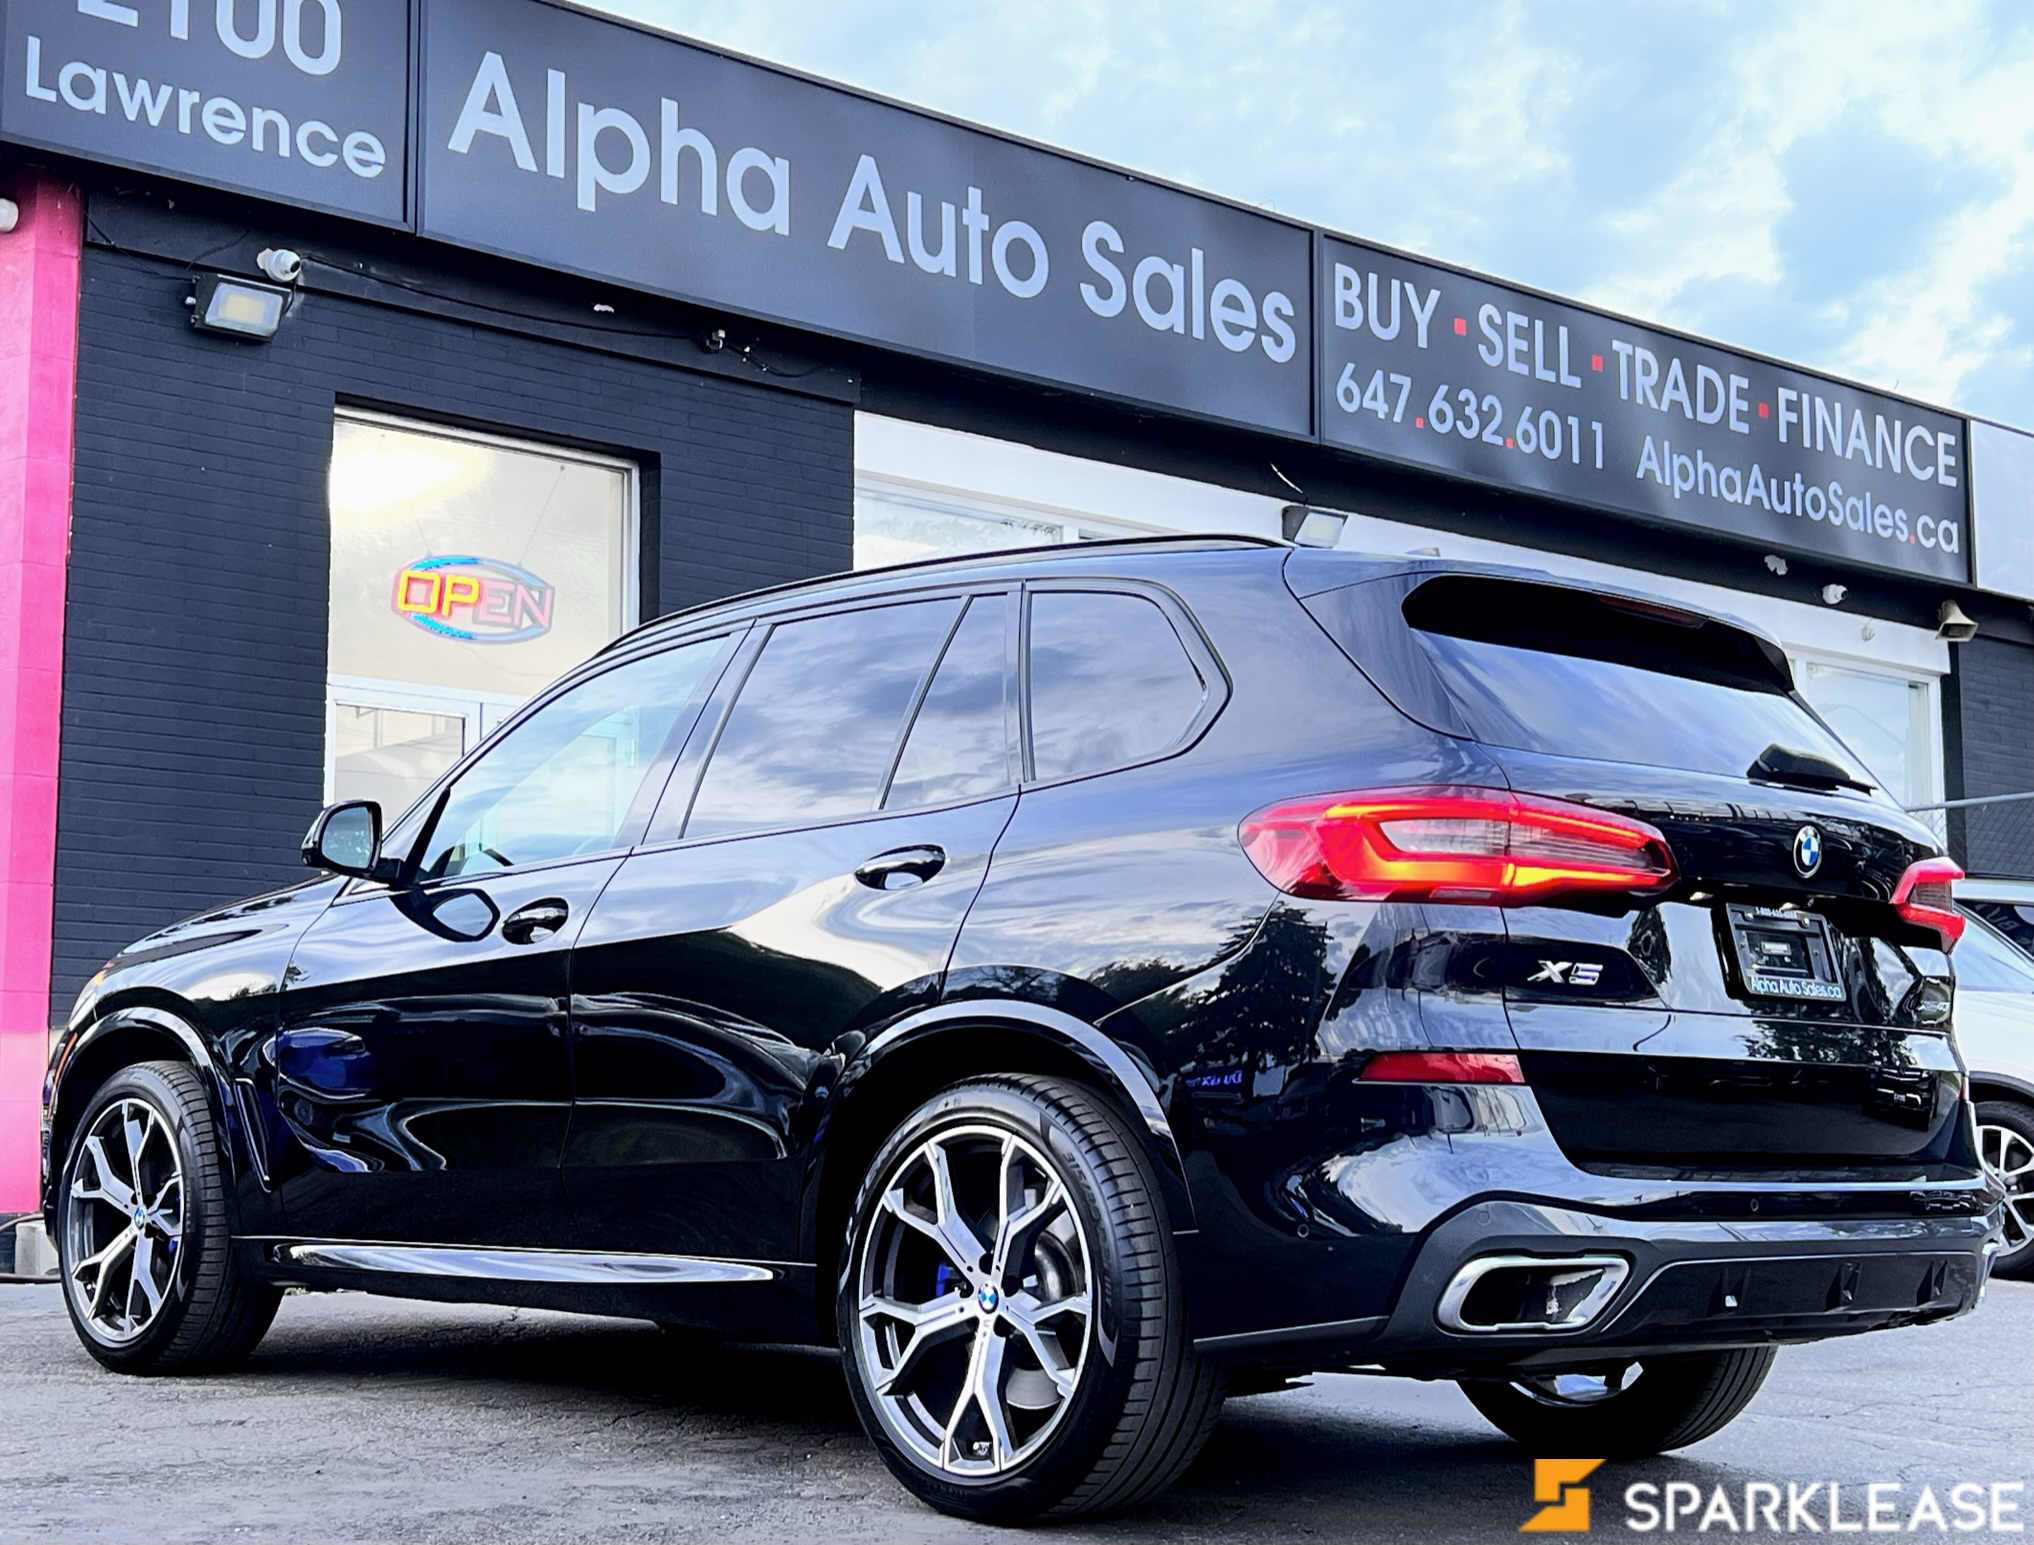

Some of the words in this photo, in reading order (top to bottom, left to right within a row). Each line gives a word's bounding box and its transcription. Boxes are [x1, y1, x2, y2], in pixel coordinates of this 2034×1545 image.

[77, 0, 342, 76] 00
[26, 36, 386, 178] Lawrence
[447, 50, 791, 237] Alpha
[827, 154, 1049, 298] Auto
[1079, 220, 1297, 364] Sales
[1334, 262, 1441, 349] BUY
[1478, 303, 1582, 389] SELL
[1612, 339, 1750, 434] TRADE
[1777, 387, 1958, 488] FINANCE
[1336, 362, 1604, 470] 647.632.6011
[1636, 435, 1960, 554] AlphaAutoSales.ca
[397, 571, 553, 629] OPEN
[1527, 959, 1603, 986] X5
